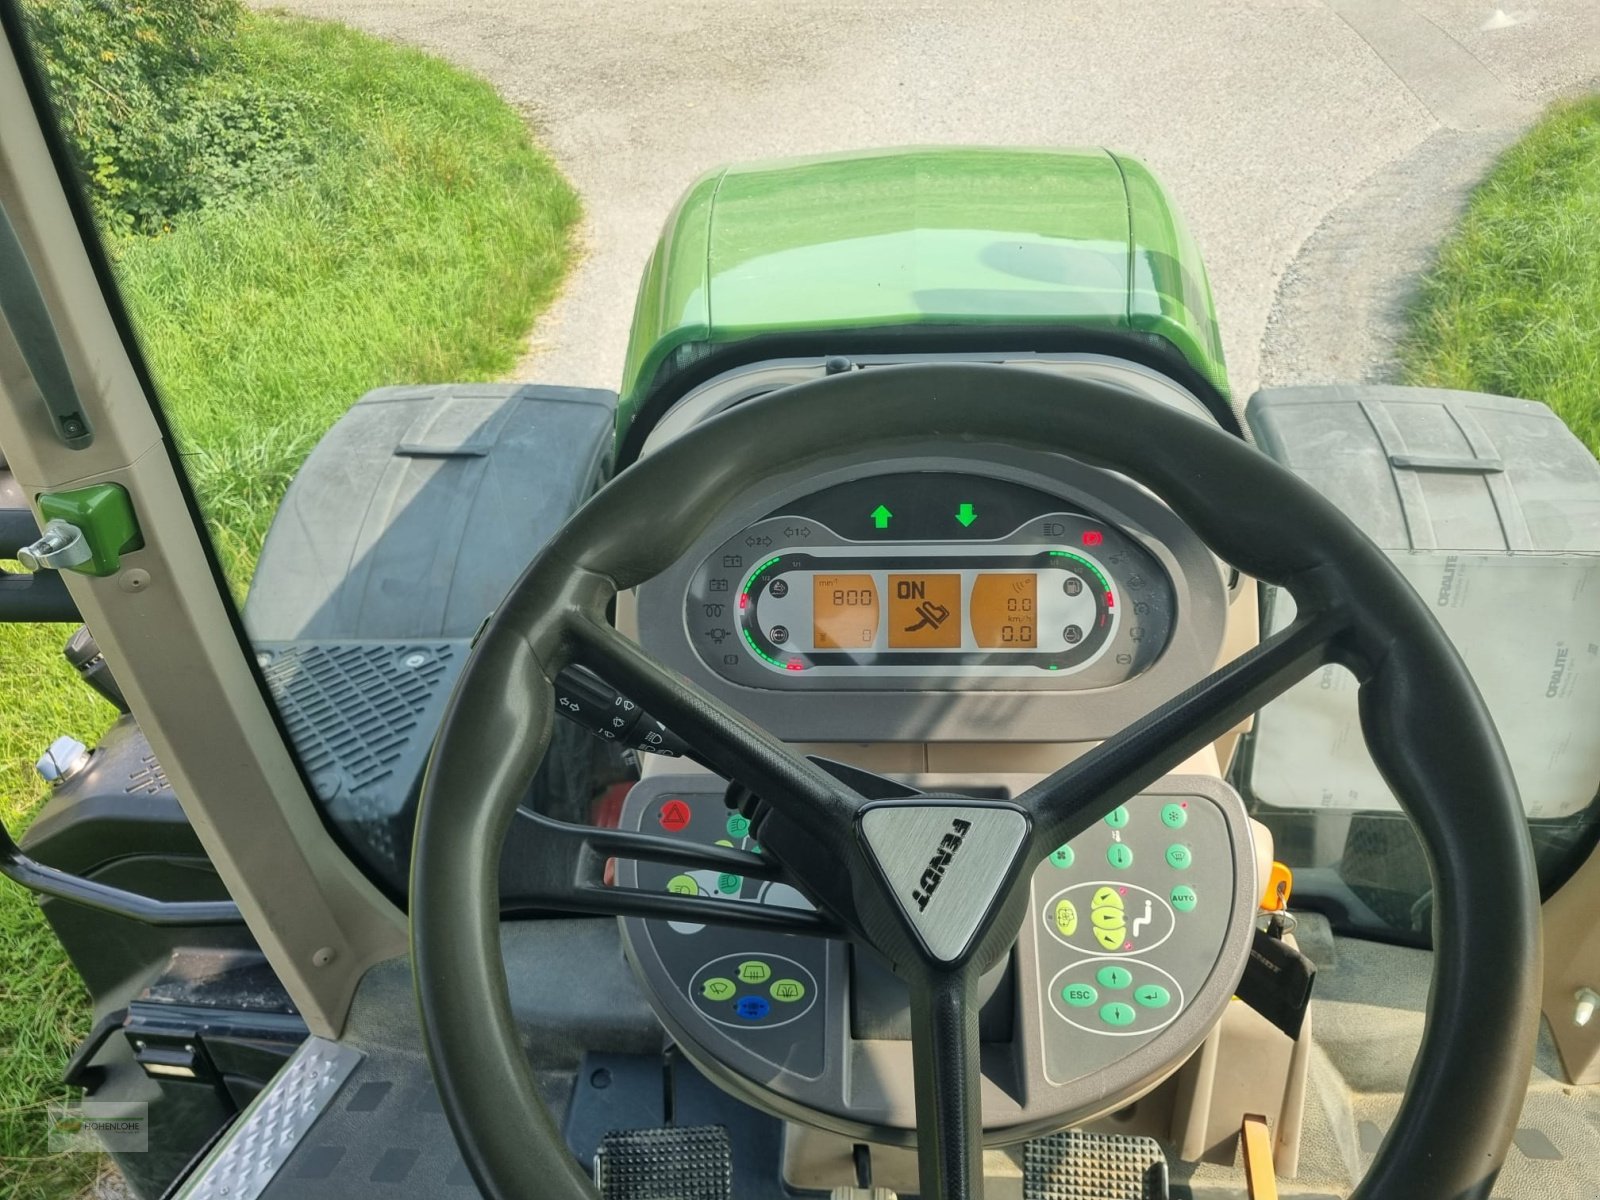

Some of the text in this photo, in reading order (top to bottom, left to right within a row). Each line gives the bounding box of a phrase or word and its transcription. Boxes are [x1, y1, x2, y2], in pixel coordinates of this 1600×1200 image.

[833, 590, 872, 606] 800
[897, 580, 925, 600] ON
[1007, 598, 1032, 612] 0.0
[1007, 614, 1032, 623] km/h
[1001, 625, 1032, 642] 0.0
[911, 818, 973, 913] FENDT
[1069, 990, 1090, 1000] ESC
